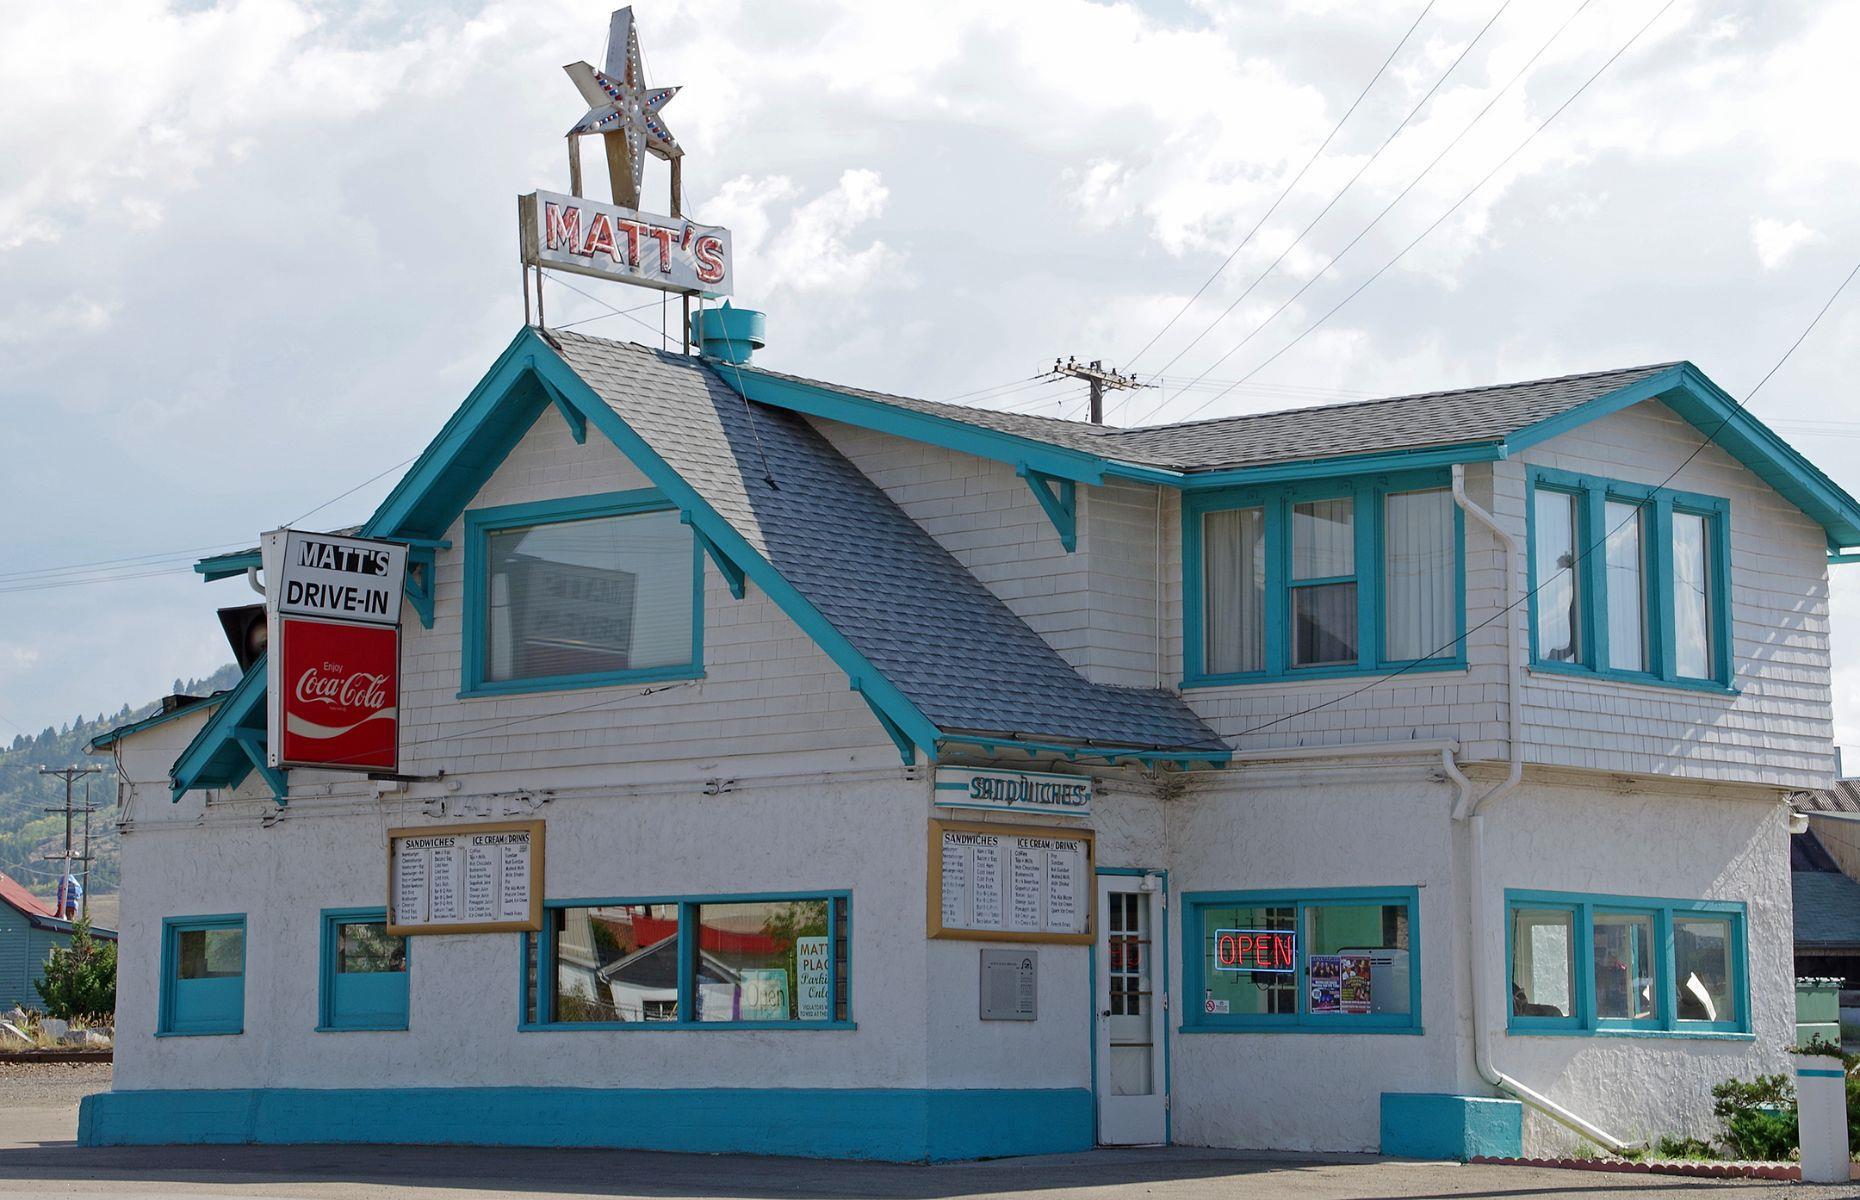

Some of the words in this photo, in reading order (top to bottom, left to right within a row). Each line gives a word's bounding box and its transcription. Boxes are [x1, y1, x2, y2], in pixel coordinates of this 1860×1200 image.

[545, 201, 726, 285] MATT'S
[298, 541, 390, 577] MATT'S
[286, 580, 389, 615] DRIVE-IN
[323, 661, 343, 673] Enjoy
[405, 837, 456, 849] SANDWICHES
[472, 836, 483, 845] ICE
[484, 834, 504, 845] CREAM
[508, 833, 530, 844] DRINKS
[944, 833, 999, 846] SANDWICHES
[1017, 838, 1029, 848] ICE
[1029, 839, 1051, 849] CREAM
[1055, 841, 1078, 851] DRINKS
[1220, 935, 1291, 965] OPEN
[747, 983, 785, 1012] Open
